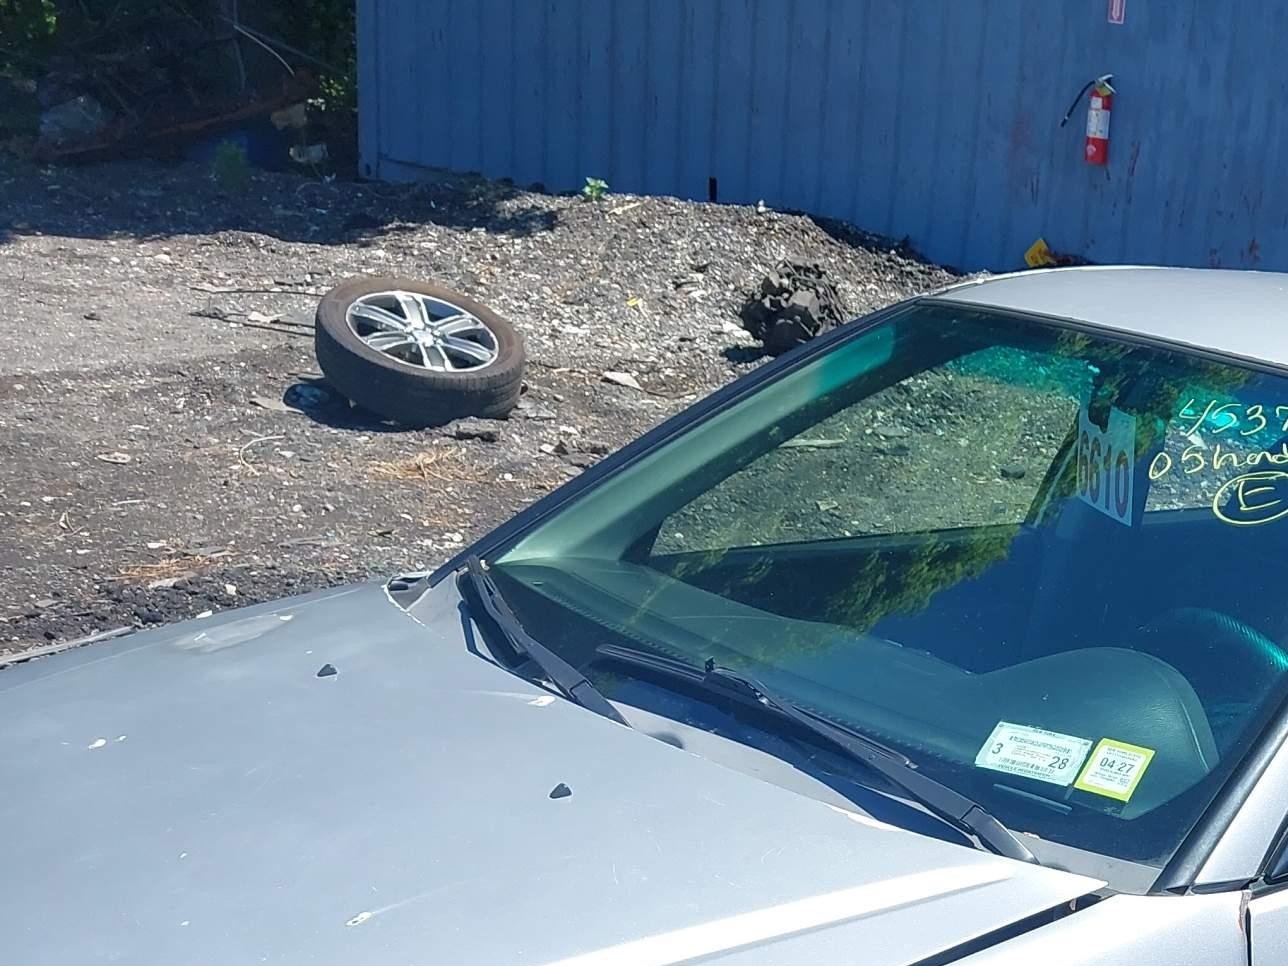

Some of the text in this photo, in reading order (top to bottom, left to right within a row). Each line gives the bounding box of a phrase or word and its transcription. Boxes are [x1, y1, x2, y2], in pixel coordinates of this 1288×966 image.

[1237, 478, 1283, 511] E
[991, 742, 1005, 755] 3
[1048, 755, 1070, 770] 28
